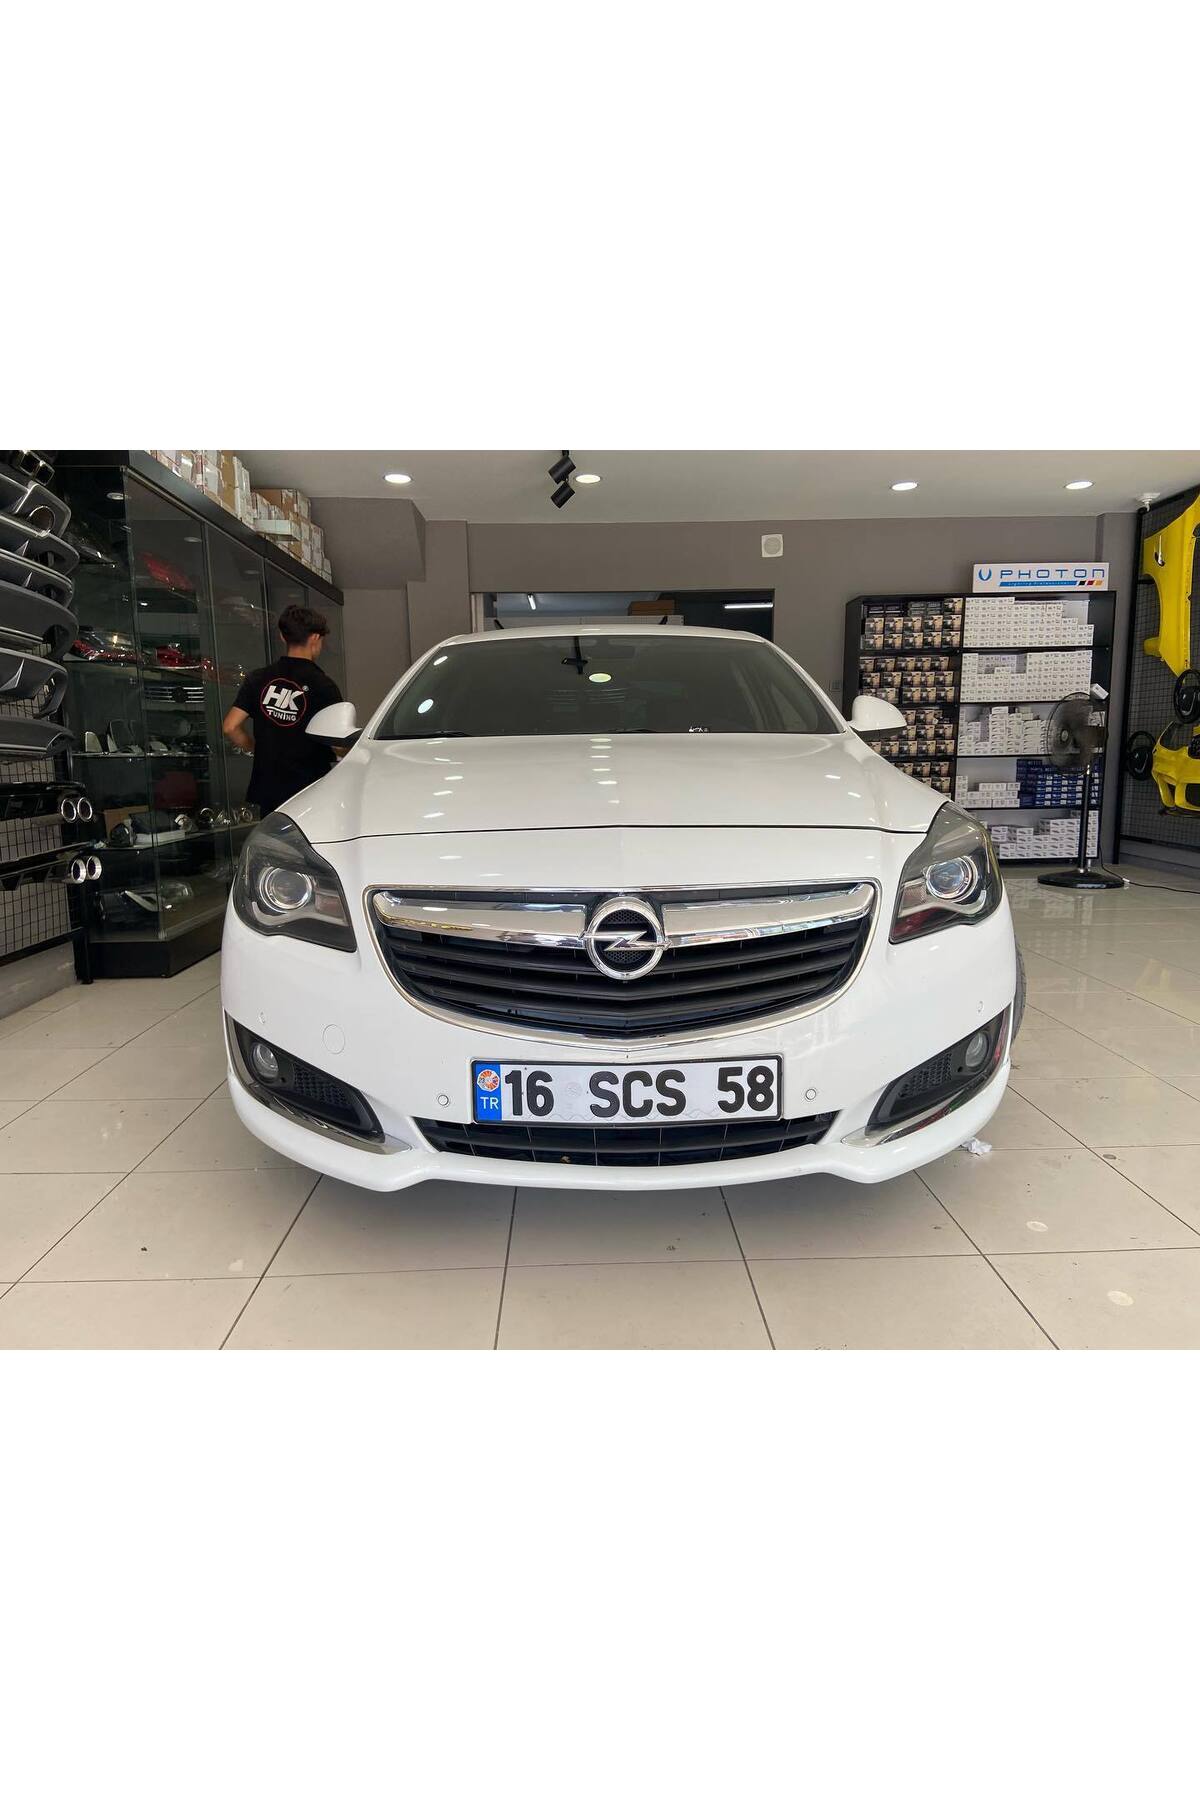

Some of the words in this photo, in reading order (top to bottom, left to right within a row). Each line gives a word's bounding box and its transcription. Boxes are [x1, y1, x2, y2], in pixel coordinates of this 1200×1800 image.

[1000, 569, 1105, 579] PHOTON
[262, 685, 304, 711] HK
[504, 1069, 555, 1117] 16
[589, 1069, 687, 1118] SCS
[717, 1065, 775, 1113] 58
[479, 1096, 500, 1110] TR
